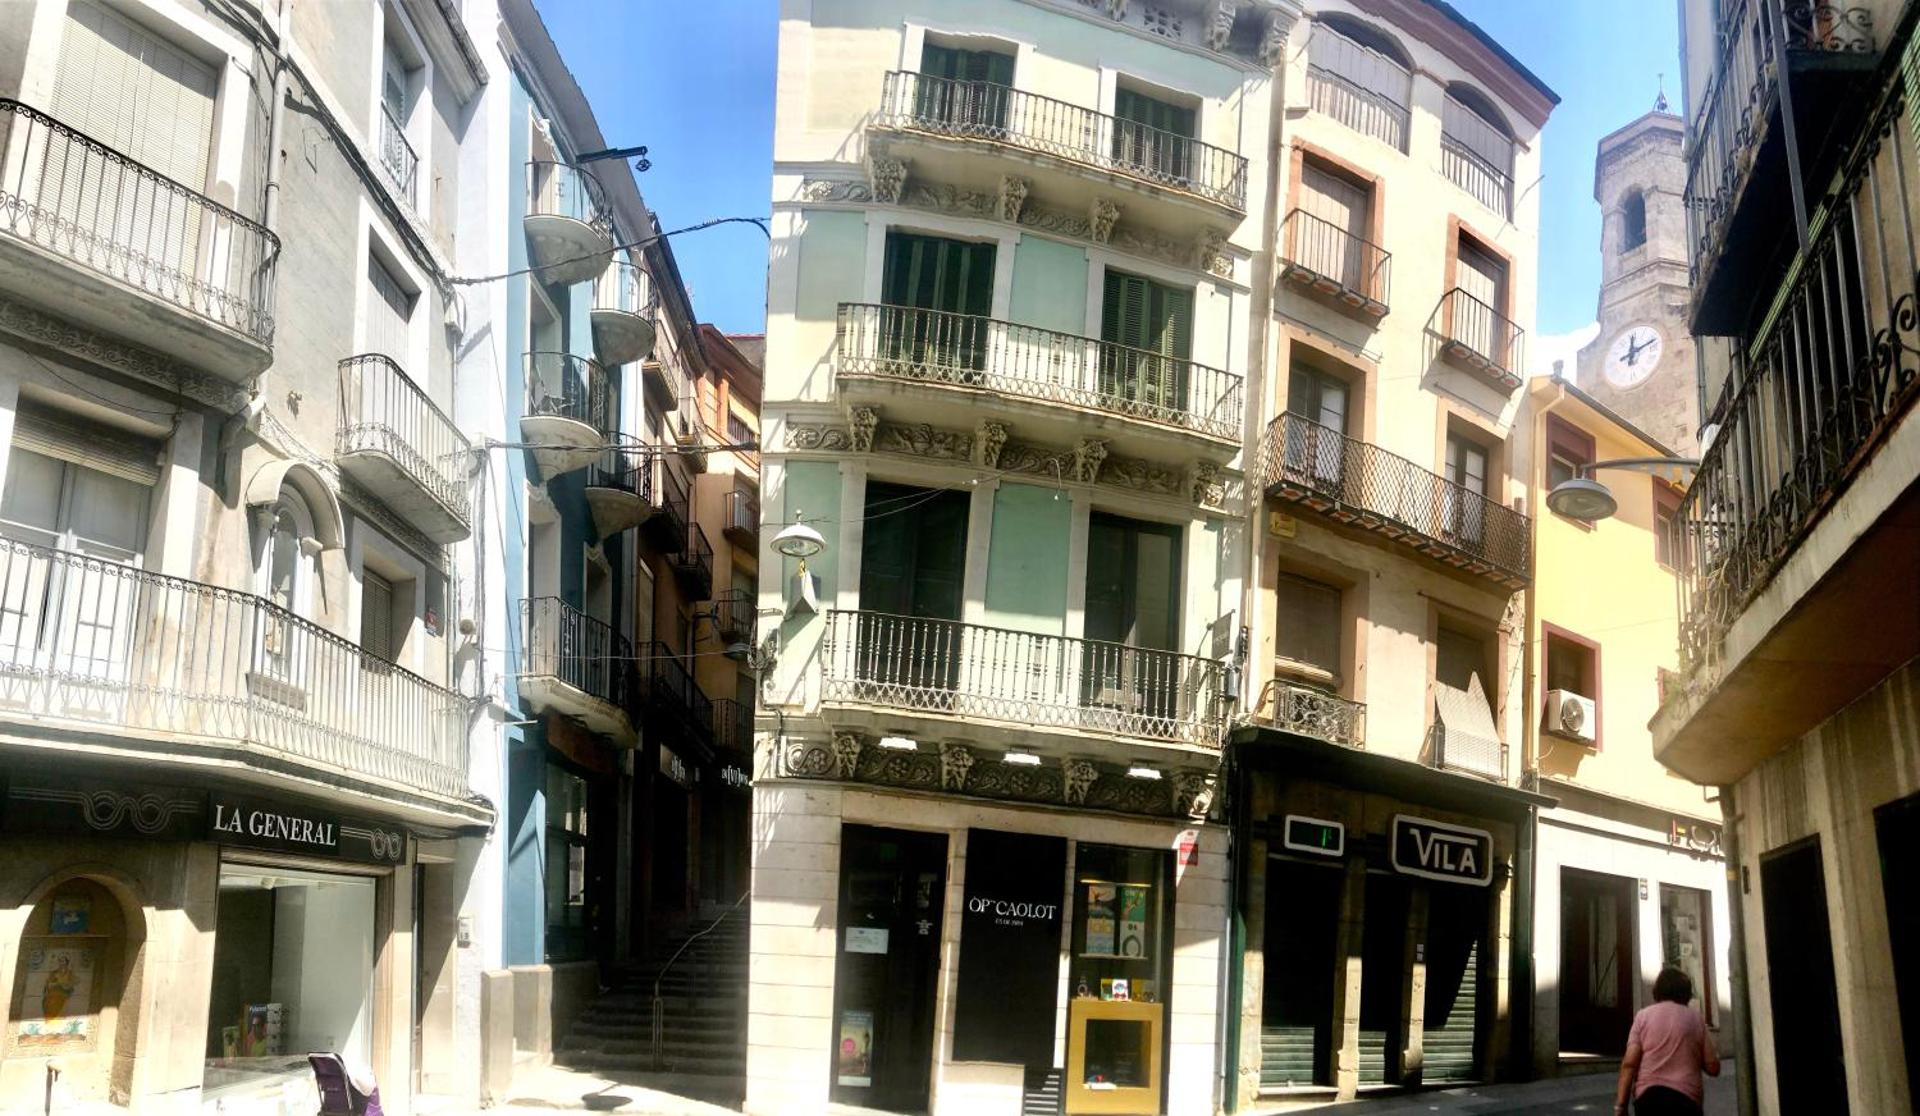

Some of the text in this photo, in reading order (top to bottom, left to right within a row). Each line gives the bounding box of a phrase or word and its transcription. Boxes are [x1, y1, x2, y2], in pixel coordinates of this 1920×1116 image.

[214, 805, 336, 846] LA GENERAL
[1409, 828, 1478, 874] VILA
[996, 901, 1057, 919] CAOLOT
